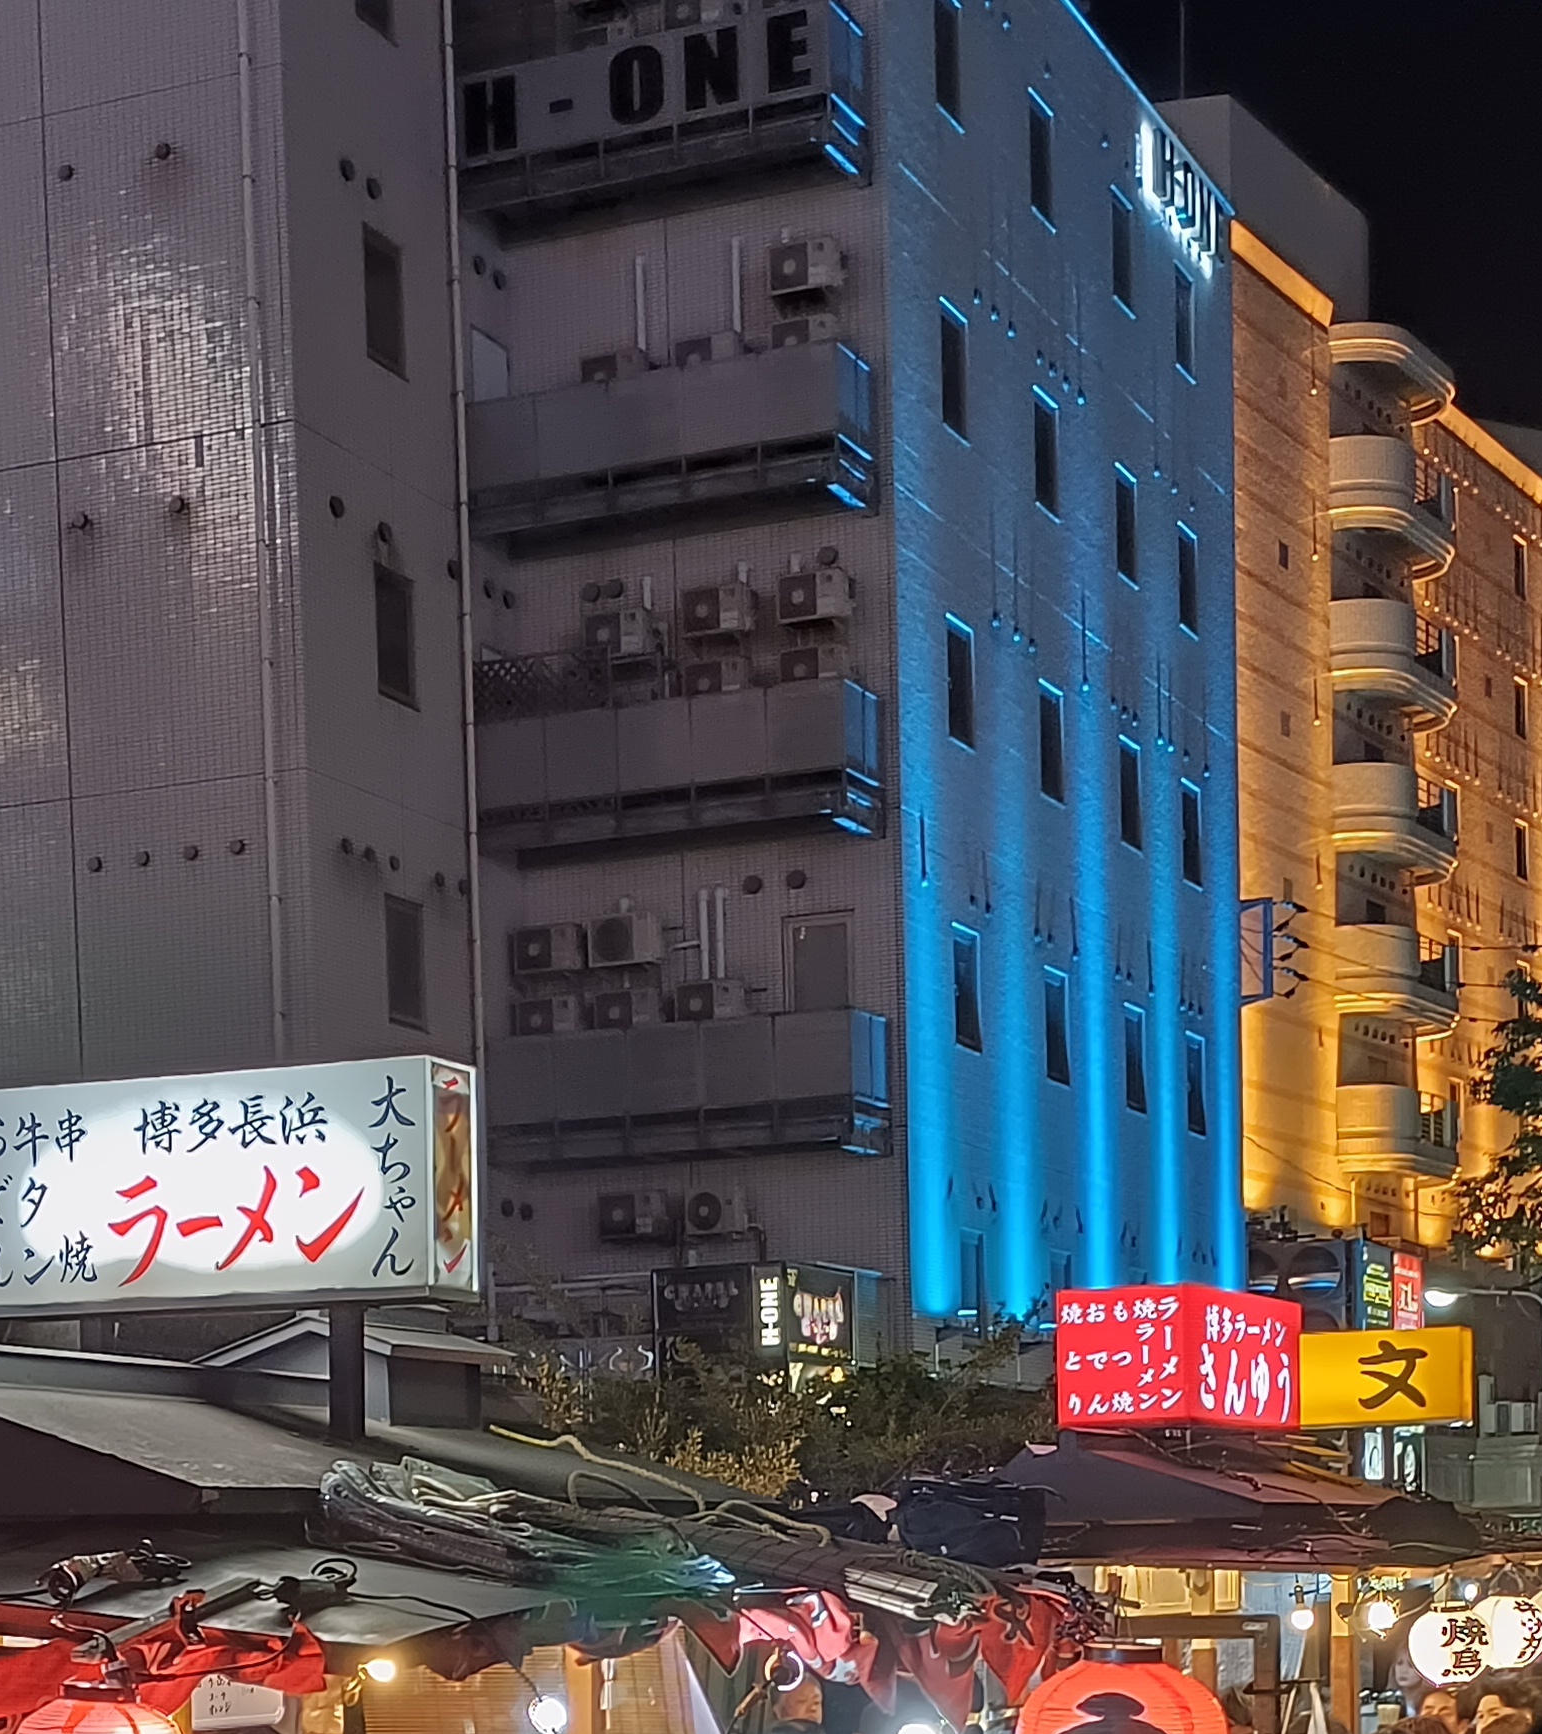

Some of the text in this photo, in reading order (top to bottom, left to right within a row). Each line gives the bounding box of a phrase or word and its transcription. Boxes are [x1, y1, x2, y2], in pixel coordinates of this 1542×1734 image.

[134, 1092, 329, 1155] 博多長浜
[369, 1074, 417, 1278] 大ちゃん
[437, 1075, 470, 1275] ラーメン
[107, 1163, 365, 1288] ラーメン
[1060, 1302, 1083, 1416] 焼とり
[1086, 1302, 1110, 1415] おでん
[1111, 1301, 1134, 1412] もつ焼
[1132, 1298, 1159, 1410] 焼ラーメン
[1157, 1295, 1183, 1410] ラーメン
[1205, 1304, 1288, 1347] 博多ラーメン
[1358, 1340, 1428, 1410] 文
[1440, 1616, 1489, 1676] 焼鳥
